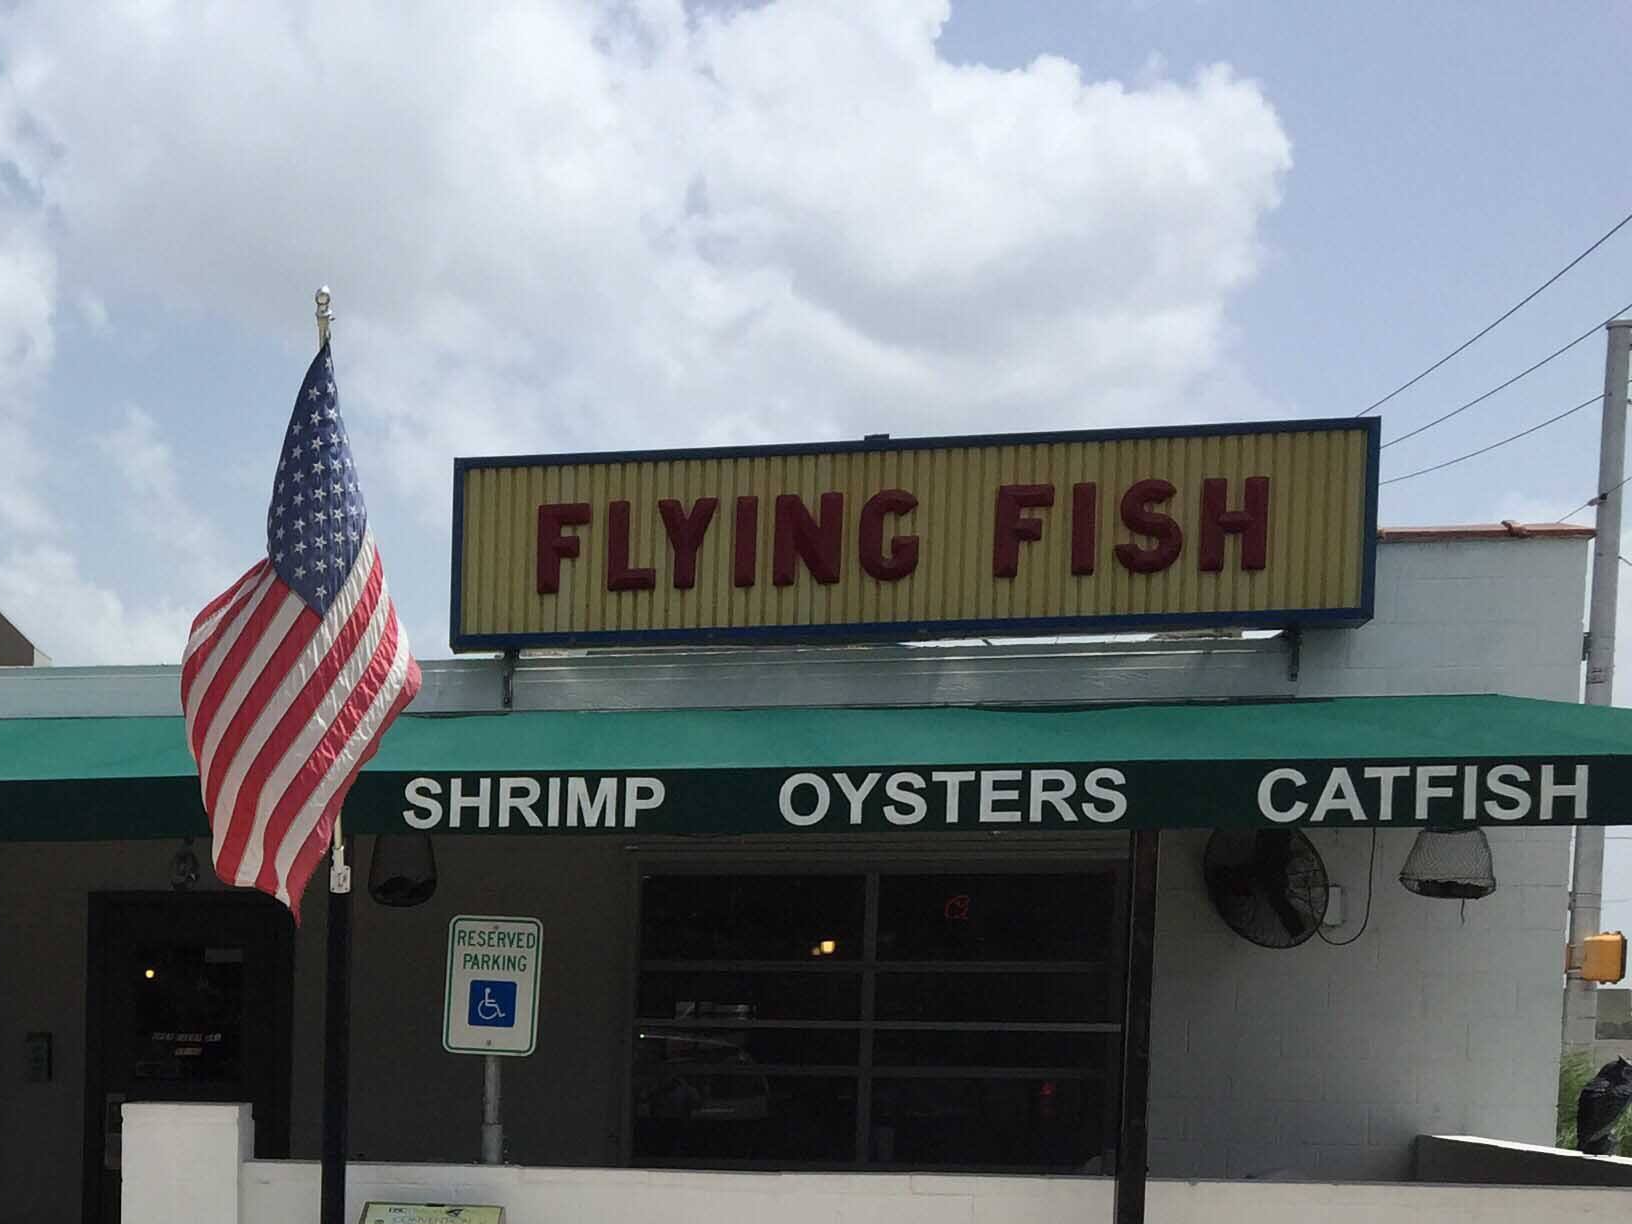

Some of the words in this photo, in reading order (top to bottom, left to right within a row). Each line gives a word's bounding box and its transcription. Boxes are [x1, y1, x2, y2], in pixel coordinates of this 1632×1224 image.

[536, 489, 920, 595] FLYING
[993, 475, 1270, 579] FISH
[402, 776, 666, 829] SHRIMP
[778, 767, 1128, 826] OYSTERS
[1257, 764, 1590, 824] CATFISH
[456, 929, 536, 950] RESERVED
[462, 953, 528, 973] PARKING
